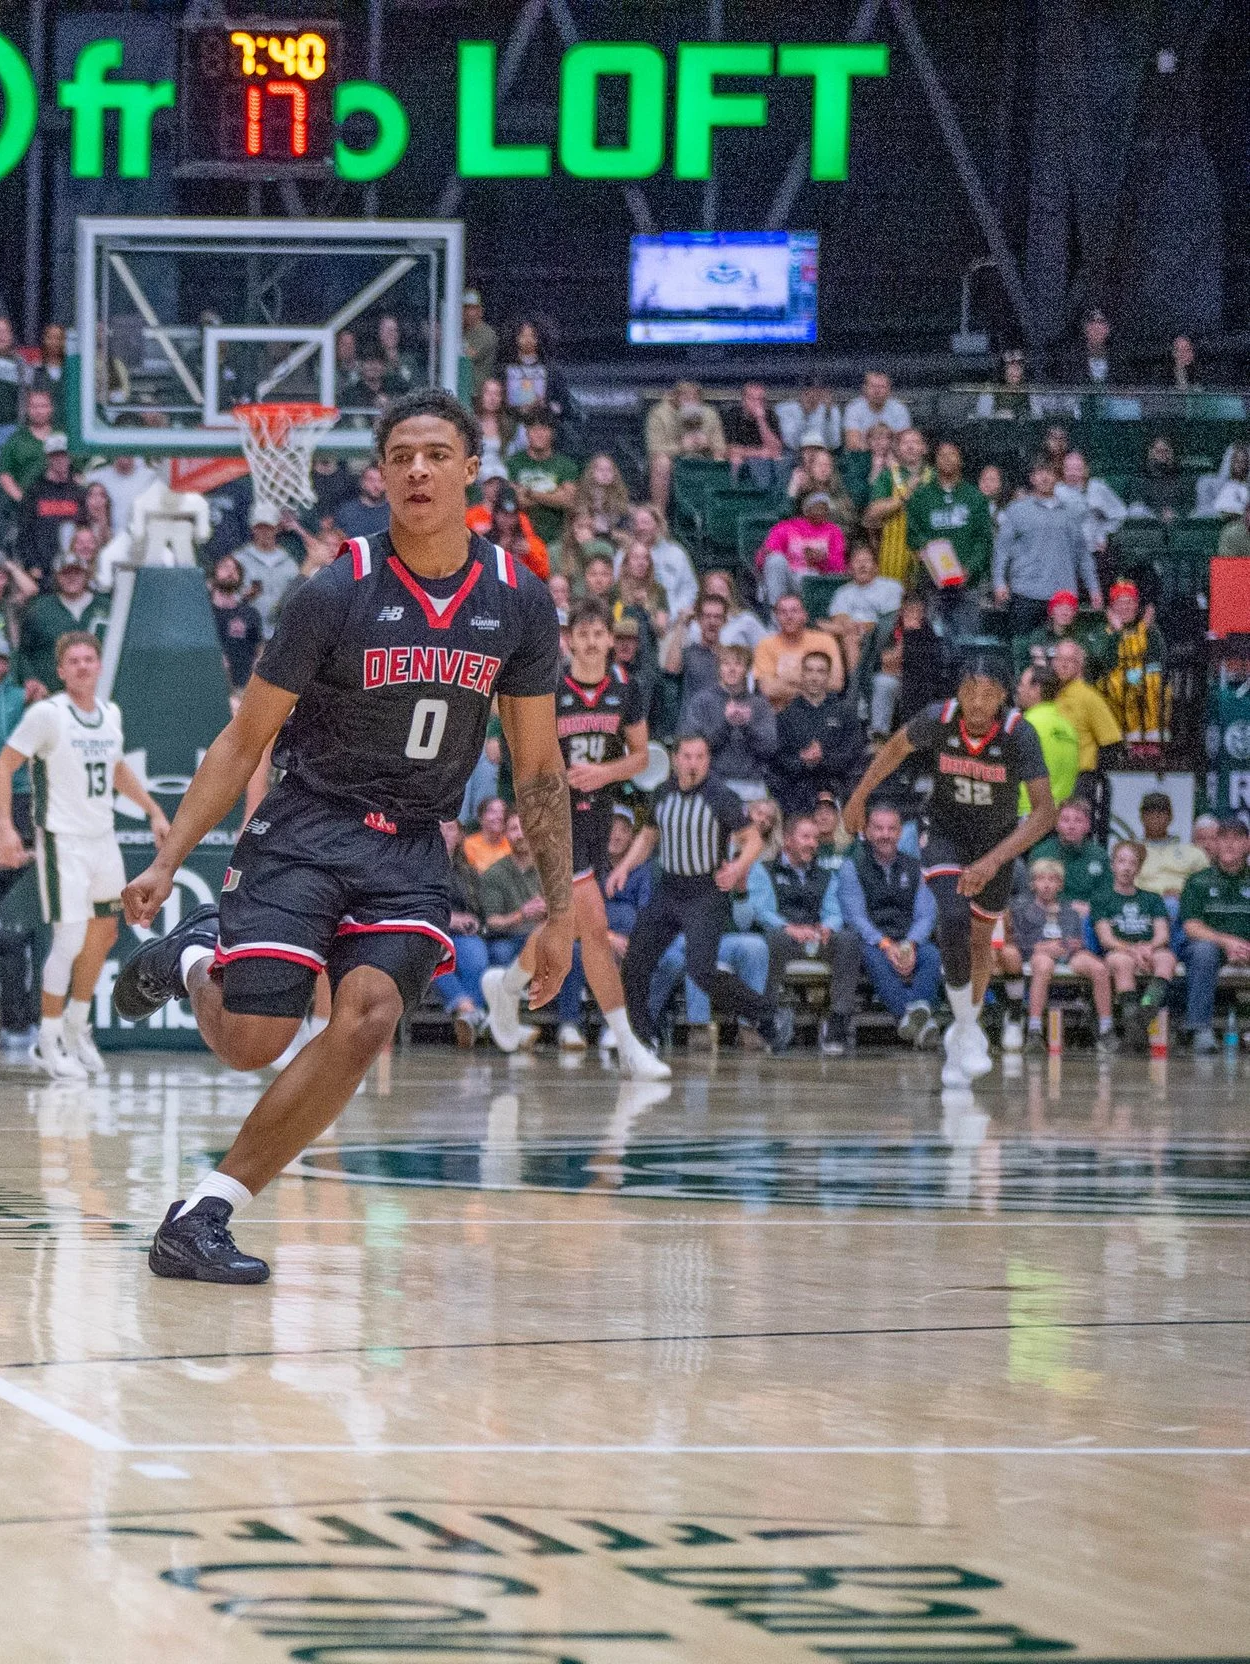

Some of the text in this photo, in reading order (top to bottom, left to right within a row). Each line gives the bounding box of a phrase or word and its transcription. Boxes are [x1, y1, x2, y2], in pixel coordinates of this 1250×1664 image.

[231, 32, 327, 81] 7:40
[246, 80, 308, 156] 17
[456, 41, 889, 181] LOFT
[363, 647, 501, 698] DENVER
[405, 699, 449, 760] 0
[85, 762, 107, 798] 13
